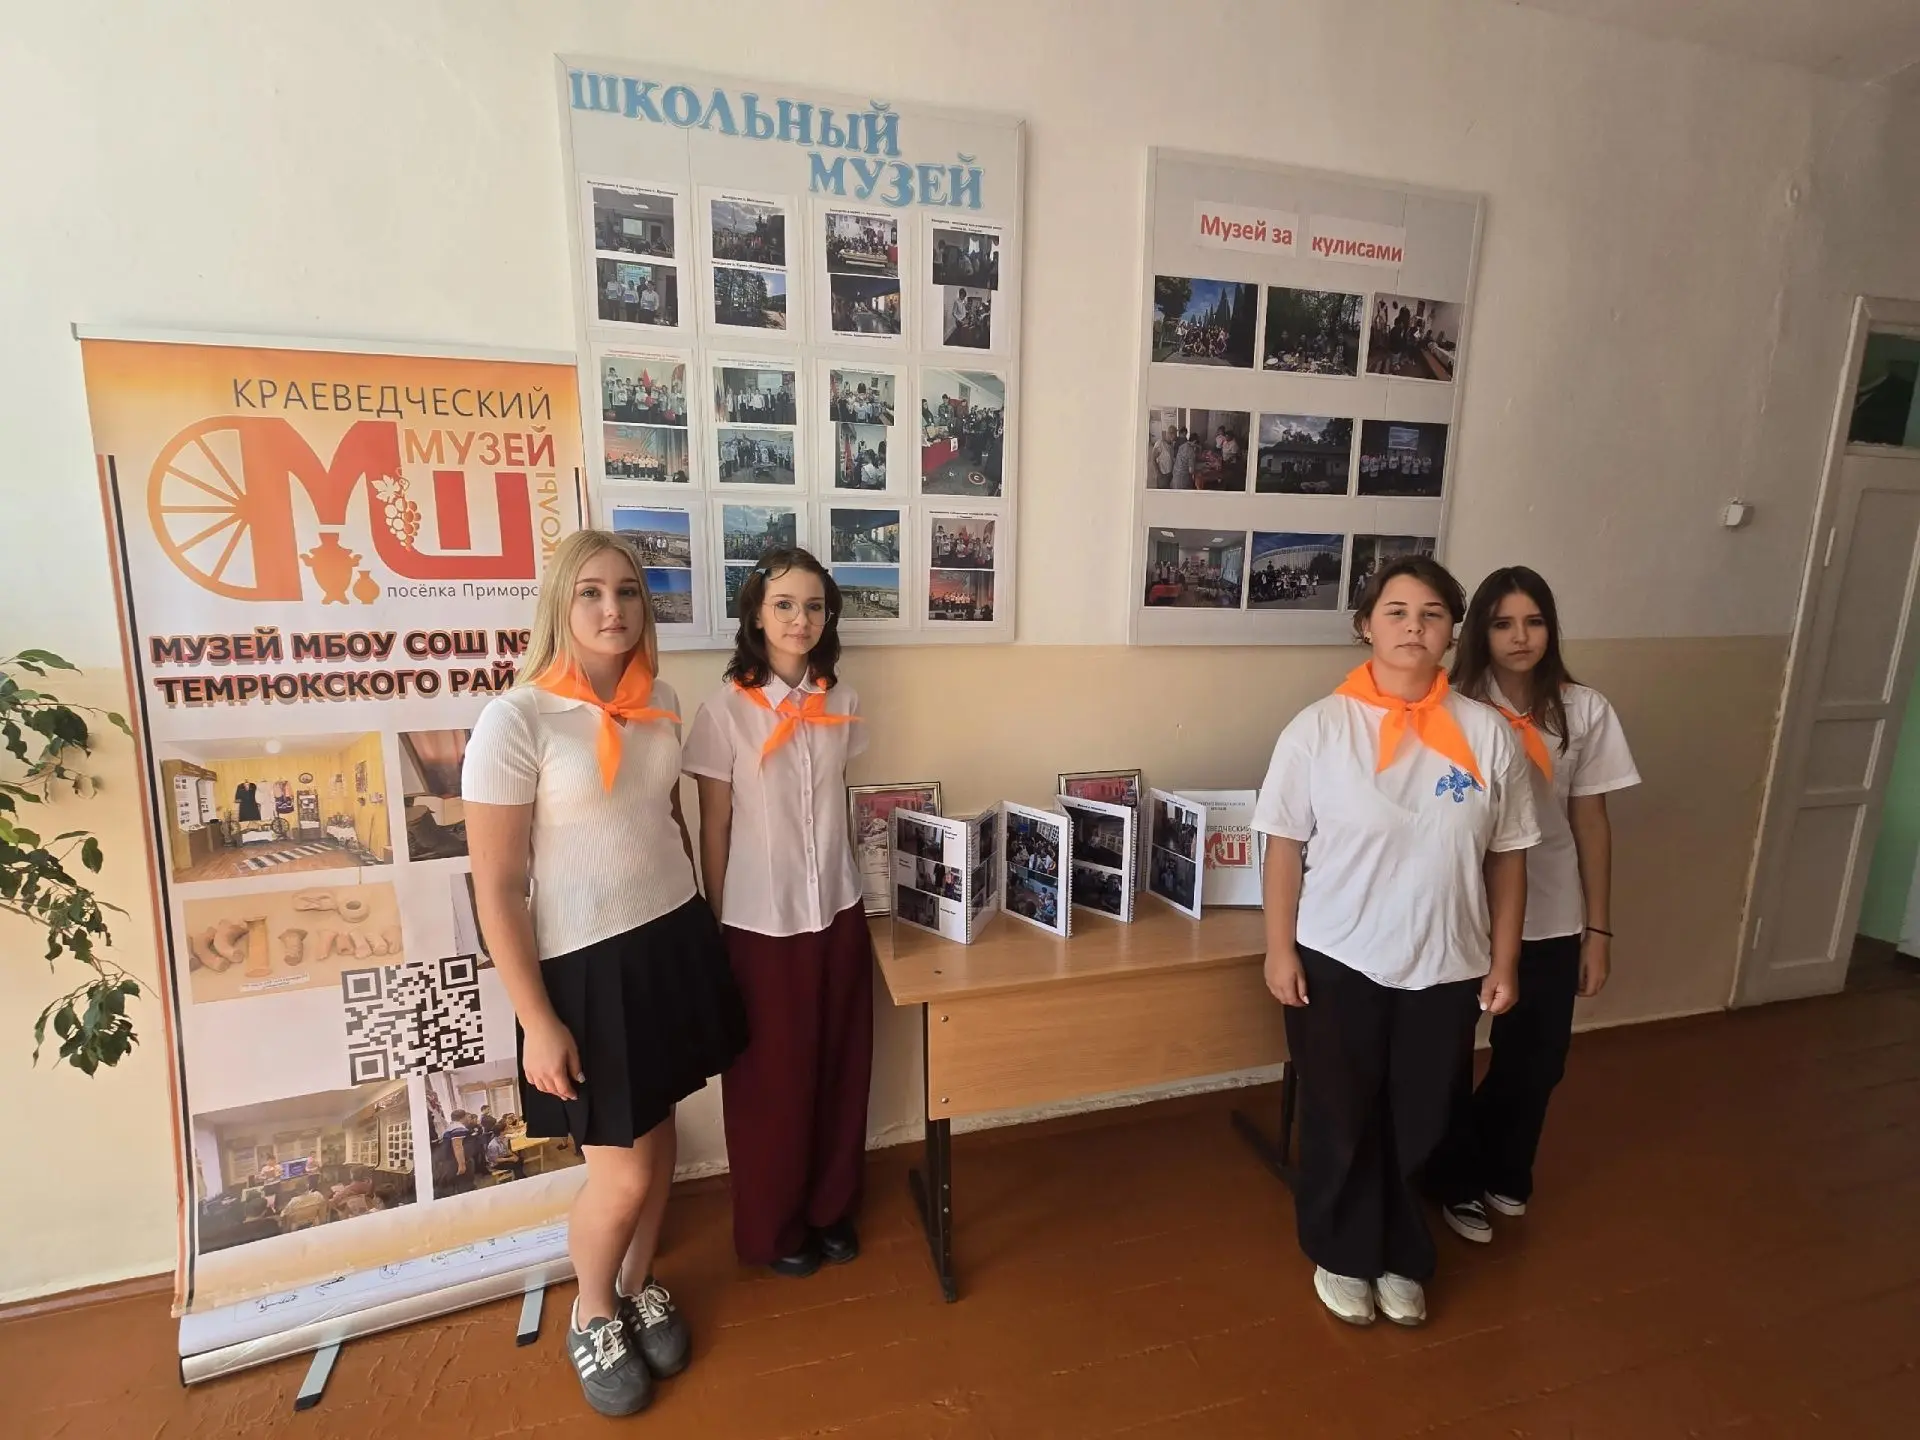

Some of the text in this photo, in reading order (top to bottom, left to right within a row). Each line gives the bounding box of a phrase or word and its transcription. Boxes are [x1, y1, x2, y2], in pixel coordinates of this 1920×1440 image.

[569, 71, 901, 157] ШКОЛЬНЫЙ
[808, 151, 985, 210] МУЗЕЙ
[1200, 214, 1403, 262] Музей за кулисами
[232, 377, 552, 420] КРАЕВЕДЧЕСКИЙ
[404, 425, 556, 467] МУЗЕЙ
[535, 472, 562, 571] КОЛЫ
[388, 583, 540, 600] посёлка Приморс
[149, 627, 284, 666] МУЗЕЙ
[291, 631, 397, 663] МБОУ
[404, 629, 489, 660] СОШ
[154, 661, 520, 708] ТЕМРЮКСКОГО РАЙ
